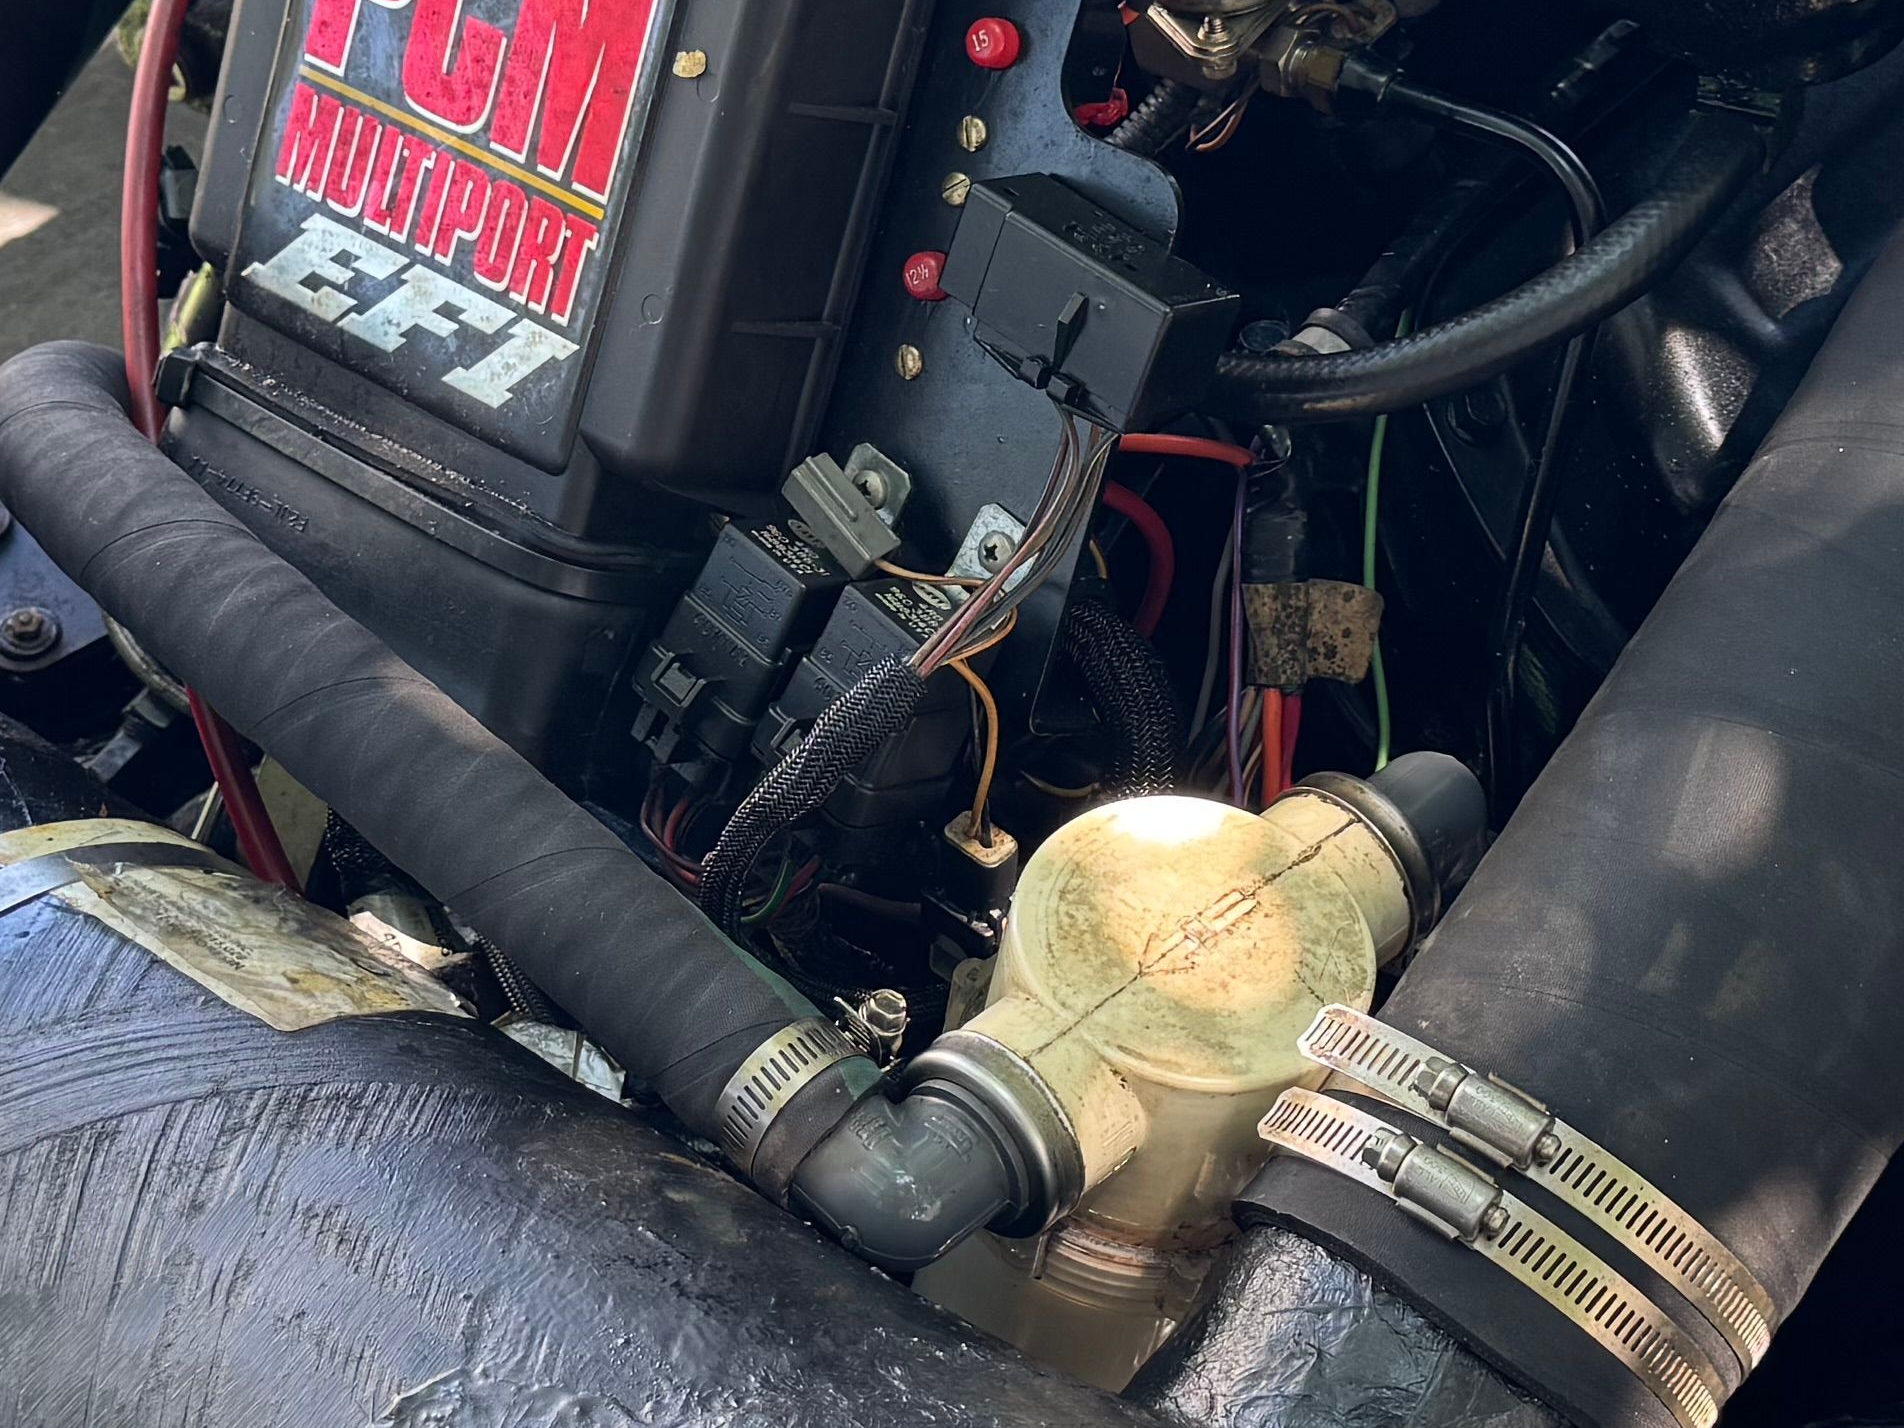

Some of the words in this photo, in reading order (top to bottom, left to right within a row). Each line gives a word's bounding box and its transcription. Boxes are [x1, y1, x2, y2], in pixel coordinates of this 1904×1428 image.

[970, 29, 990, 53] 15
[275, 83, 600, 327] MULTIPORT
[241, 213, 580, 409] EFI
